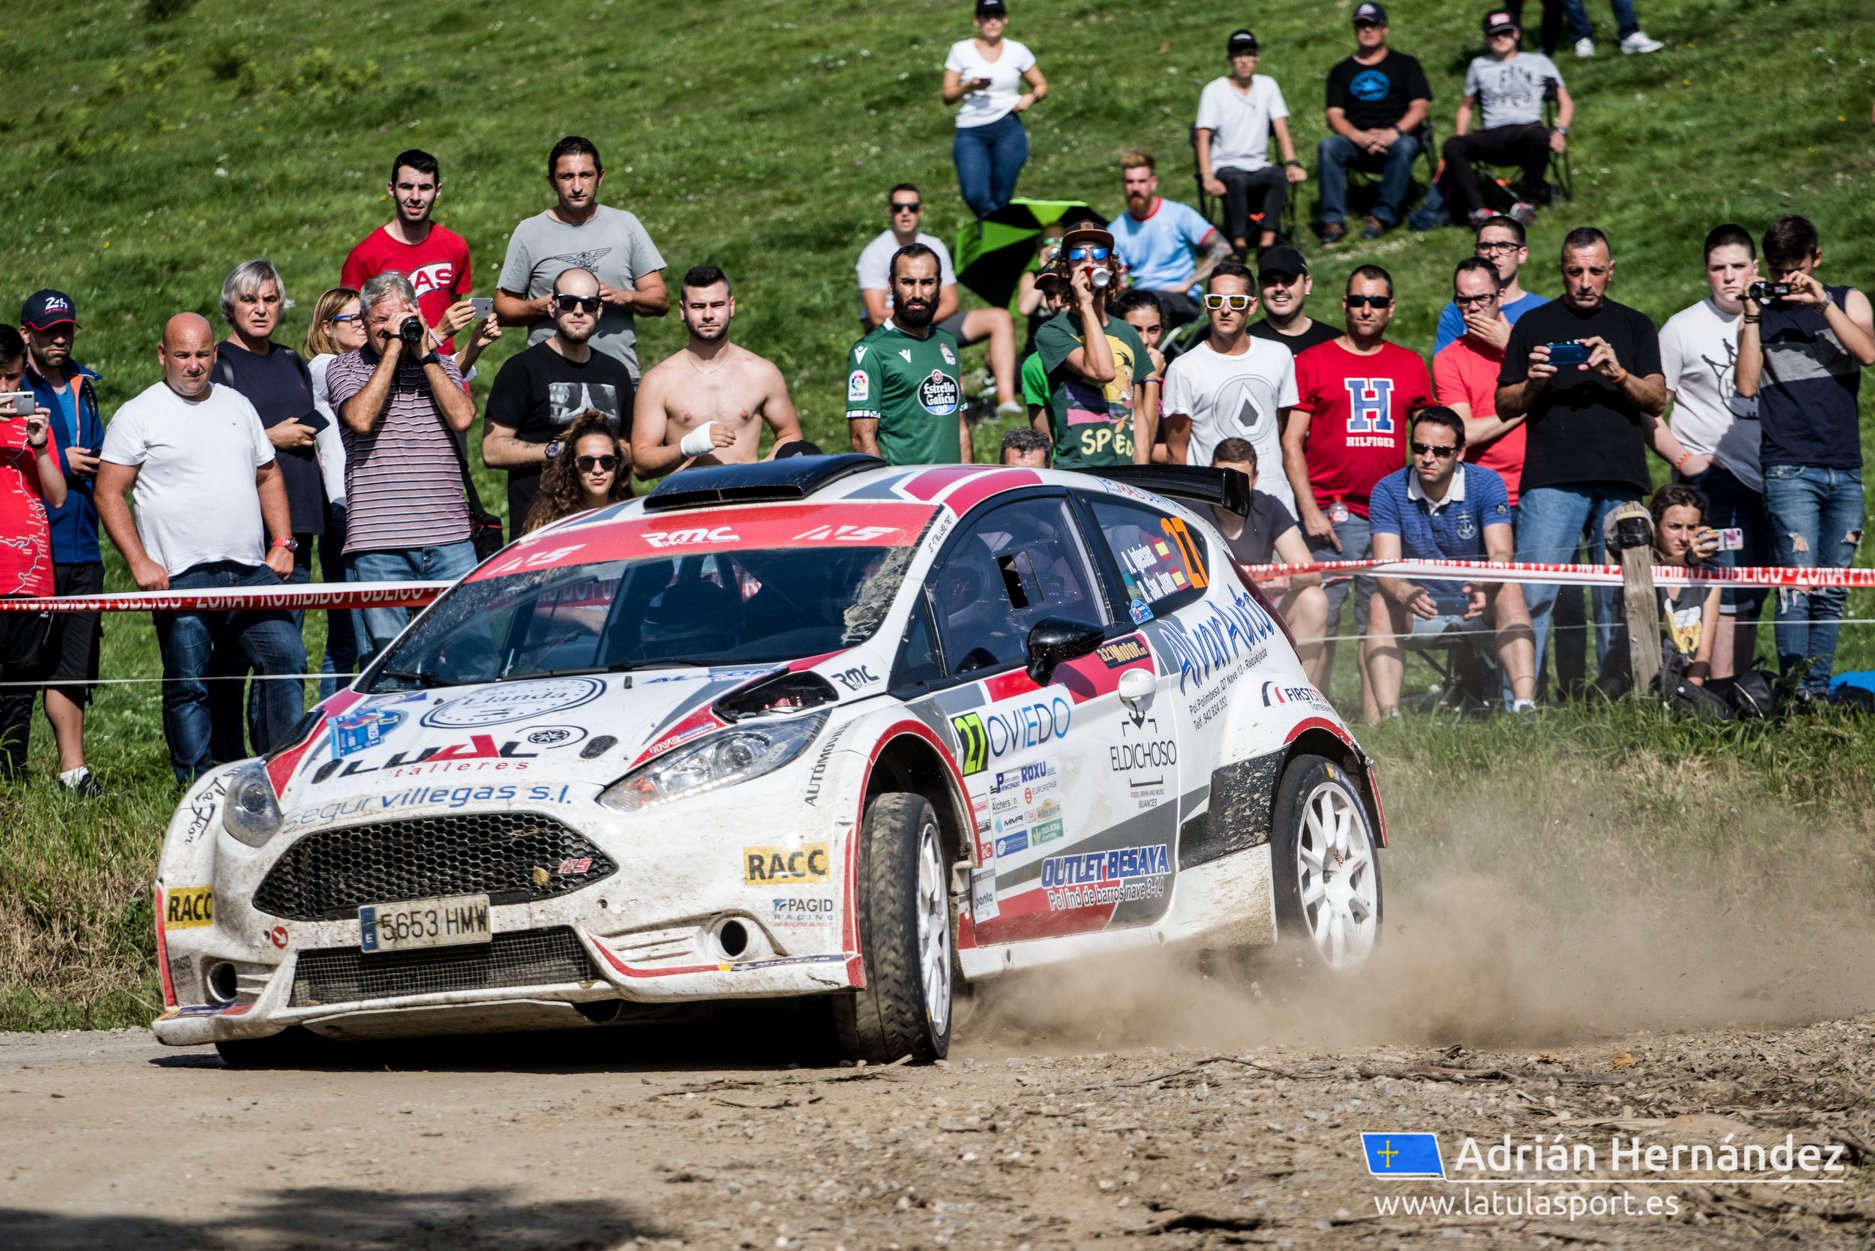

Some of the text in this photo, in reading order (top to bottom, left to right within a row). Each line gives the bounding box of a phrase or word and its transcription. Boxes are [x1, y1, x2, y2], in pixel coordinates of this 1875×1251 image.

[924, 381, 955, 395] Estrella
[926, 393, 955, 406] Galicia
[1344, 377, 1395, 434] H
[1346, 436, 1395, 448] HILFIGER
[1161, 517, 1209, 589] 27
[987, 697, 1071, 757] OVIEDO
[954, 714, 986, 776] 27
[392, 759, 530, 779] talleres
[1021, 761, 1047, 783] ROXU
[381, 783, 517, 809] villegas
[528, 783, 572, 804] s.l.
[1138, 799, 1158, 809] SUANCES
[748, 849, 826, 880] RACC
[1041, 843, 1172, 889] OUTLET BESAYA
[168, 893, 213, 922] RACC
[788, 898, 833, 912] PAGID
[1065, 887, 1082, 909] ind
[1083, 885, 1095, 907] de
[1095, 883, 1124, 905] barros
[380, 903, 488, 942] 5653 HMW
[365, 933, 374, 943] E
